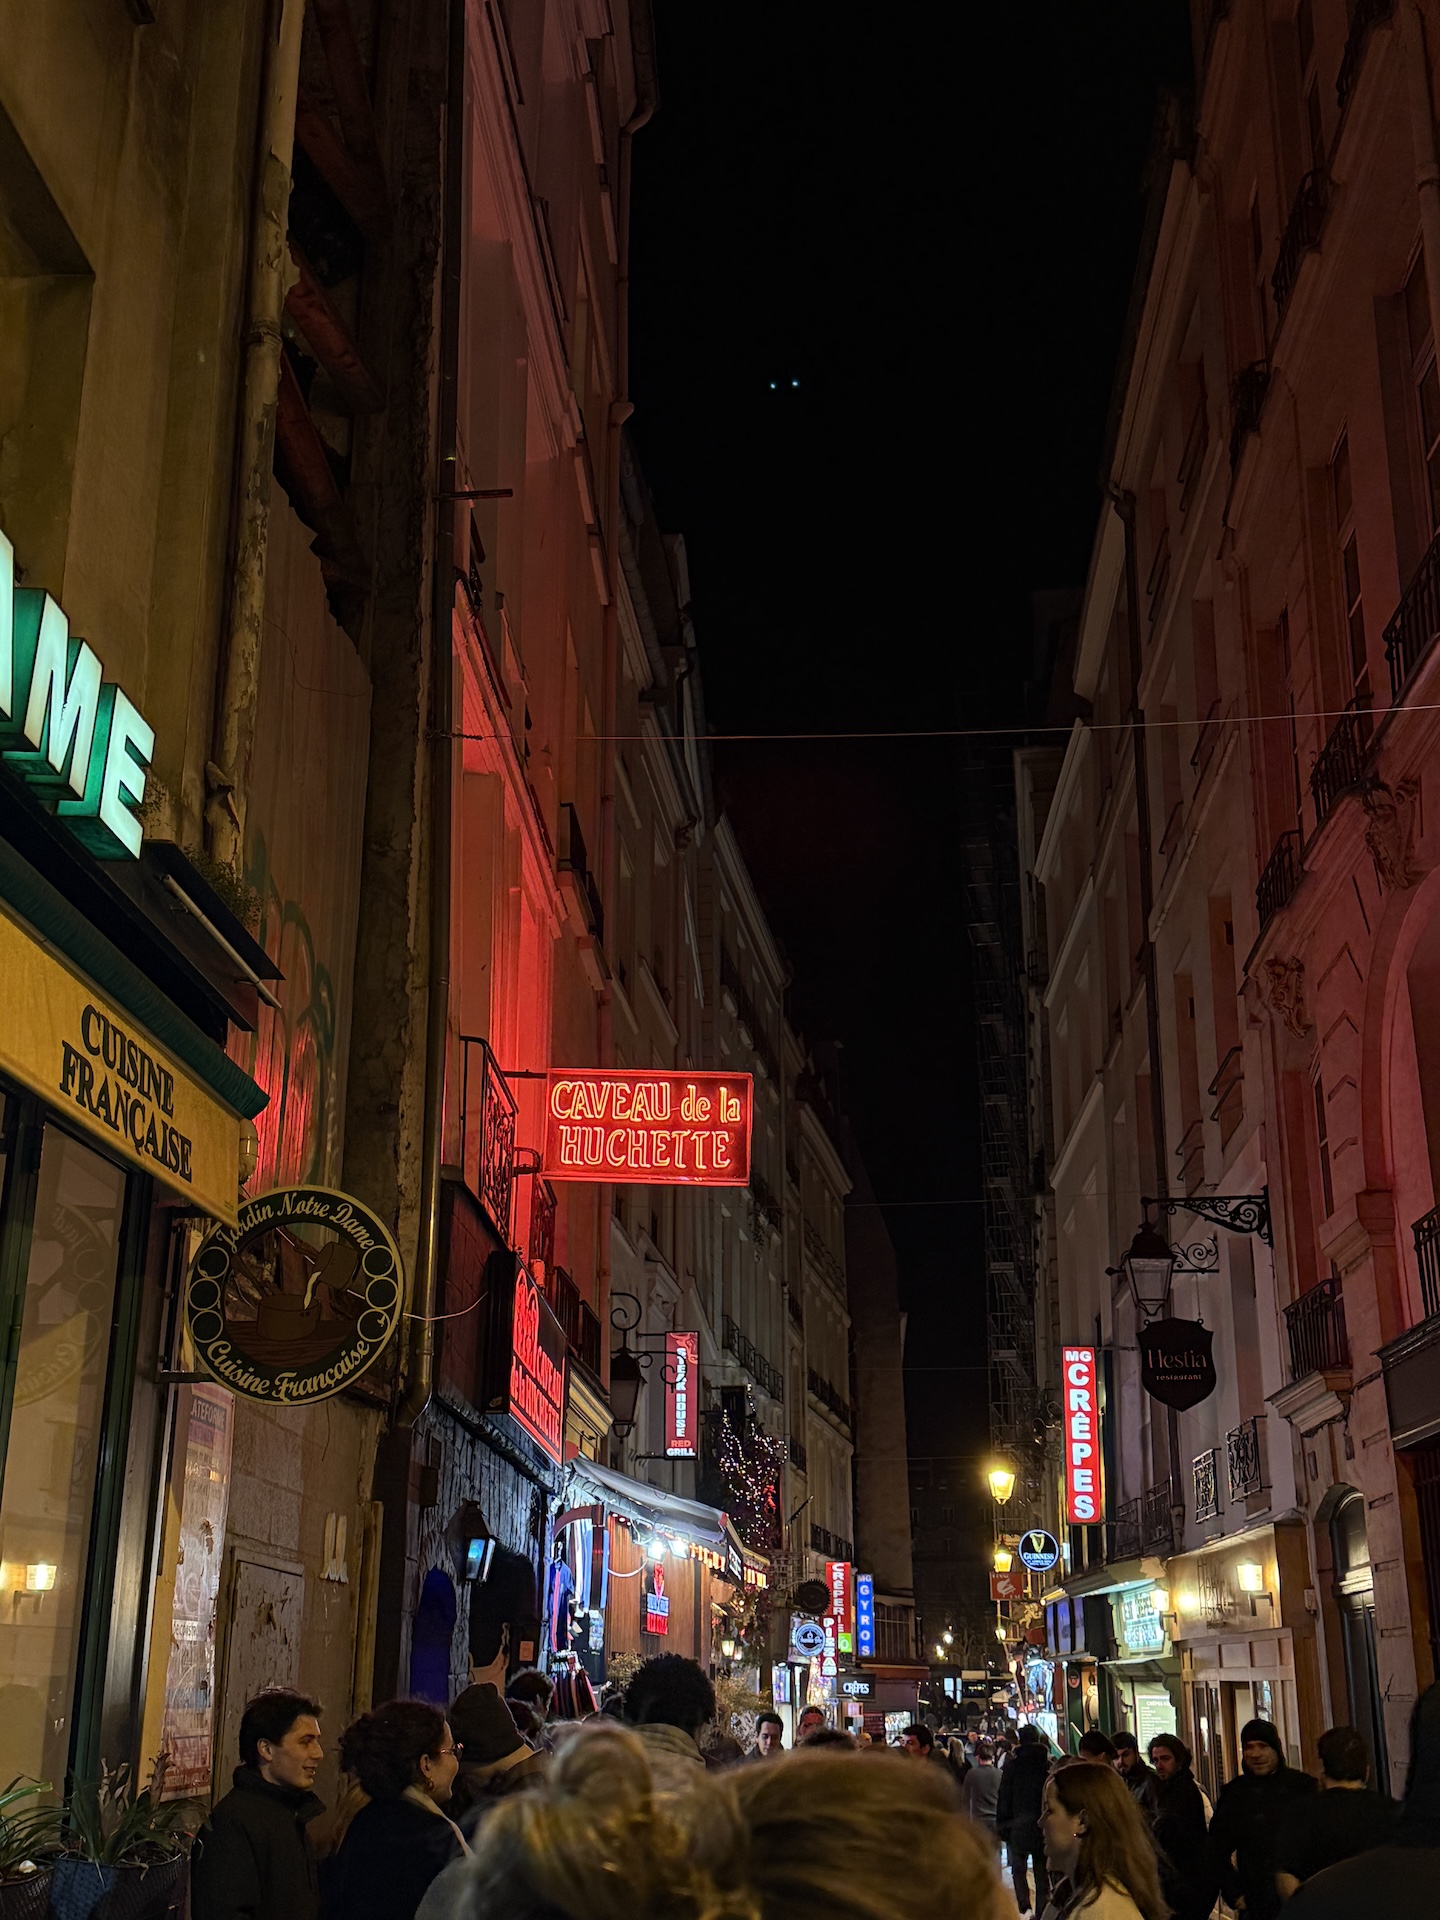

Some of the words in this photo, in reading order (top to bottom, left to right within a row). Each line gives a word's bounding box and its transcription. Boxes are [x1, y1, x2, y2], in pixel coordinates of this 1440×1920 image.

[81, 1004, 174, 1119] CUISINE
[59, 1040, 192, 1183] FRANÇAISE
[551, 1081, 671, 1122] CAVEAU
[681, 1085, 711, 1122] de
[719, 1086, 741, 1123] la
[559, 1125, 731, 1169] HUCHETTE
[277, 1192, 330, 1218] Notre
[330, 1202, 375, 1250] Dame
[207, 1340, 270, 1394] Cuisine
[271, 1340, 370, 1403] Française
[1064, 1350, 1092, 1362] MG
[1148, 1349, 1207, 1369] Hestia
[675, 1393, 688, 1437] HOUSE
[666, 1448, 696, 1457] GRILL
[1067, 1363, 1095, 1519] CRÊPES
[823, 1617, 836, 1666] PIZZA
[860, 1584, 871, 1656] GYROS
[843, 1680, 869, 1694] CRÊPES
